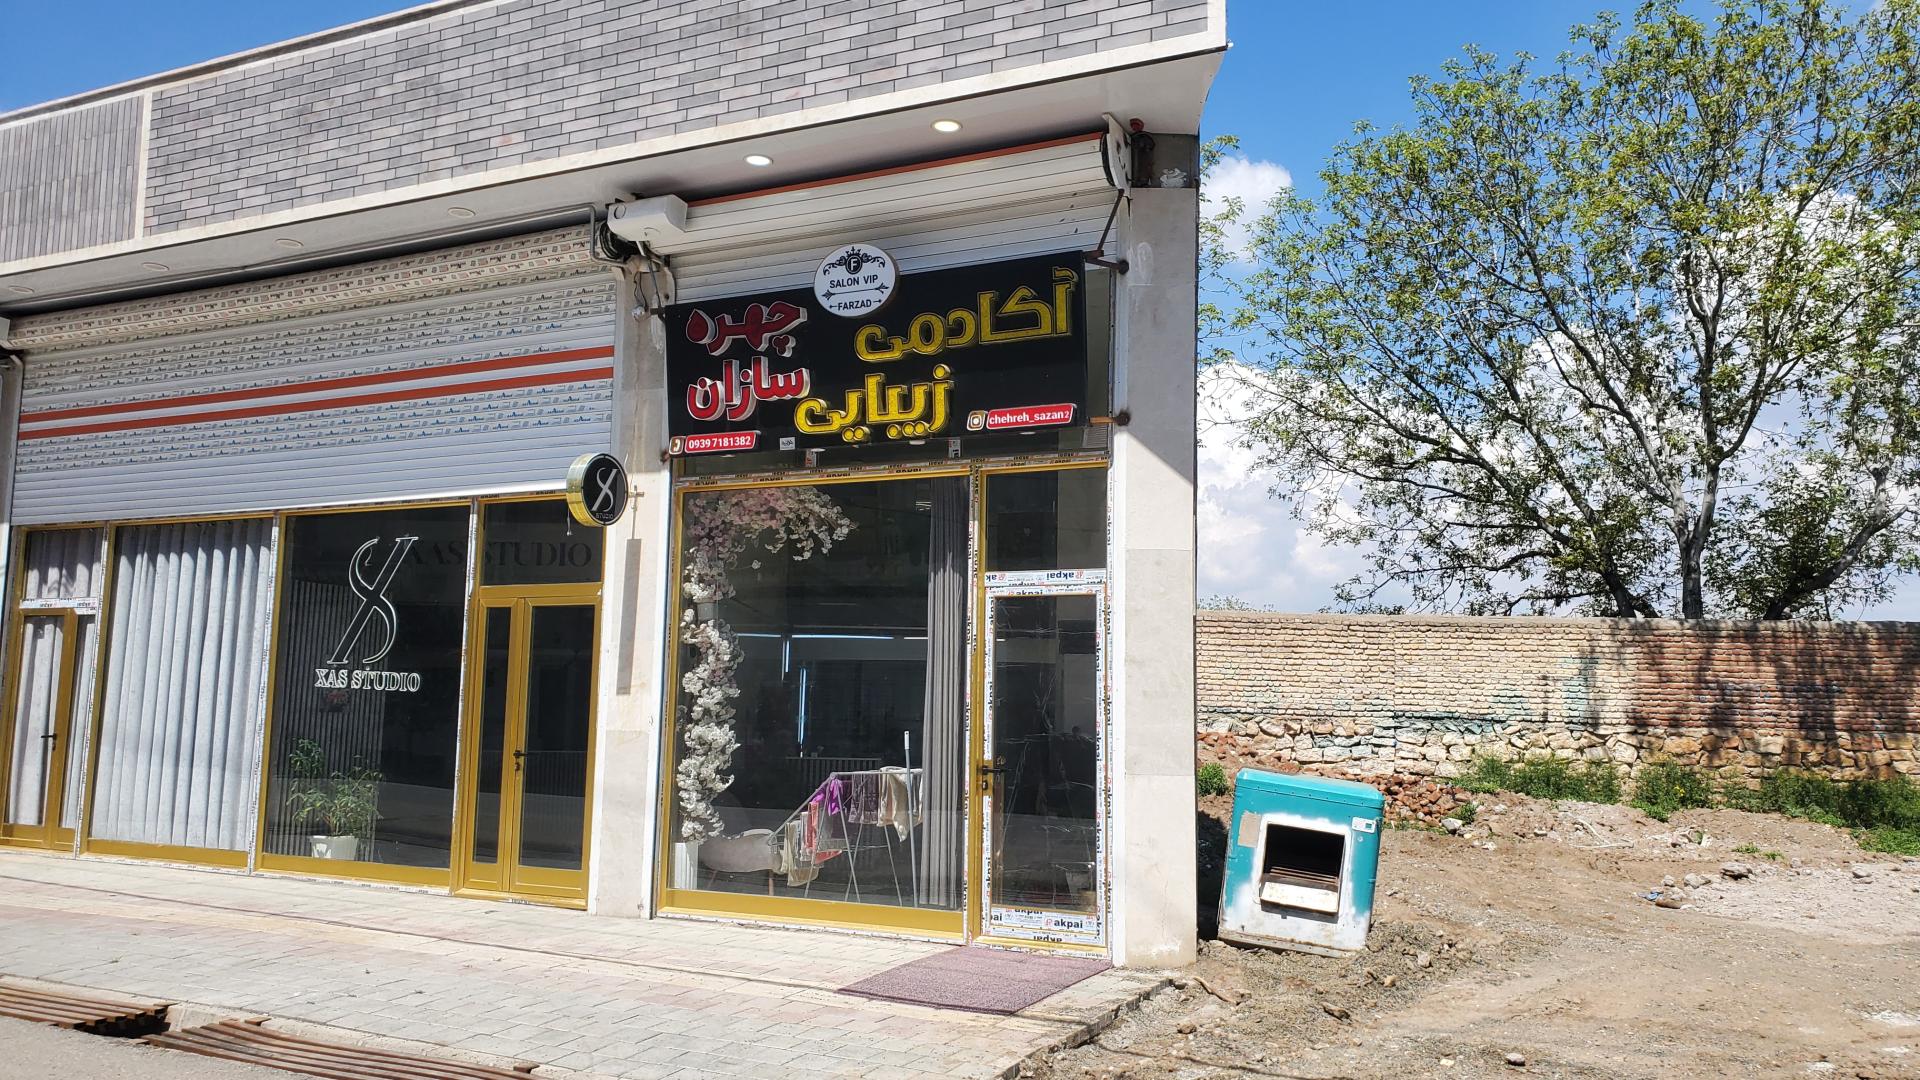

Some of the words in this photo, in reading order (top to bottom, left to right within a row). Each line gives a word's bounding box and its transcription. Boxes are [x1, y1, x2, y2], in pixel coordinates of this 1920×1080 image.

[829, 276, 860, 289] SALON
[863, 274, 879, 285] VIP
[837, 299, 872, 311] FARZAD
[686, 301, 807, 356] چهره
[687, 356, 810, 421] سازان
[794, 364, 954, 443] زیبایی
[989, 411, 1070, 425] chehreh_sazan2
[314, 668, 349, 689] XAS
[350, 669, 421, 692] STUDIO
[1053, 918, 1083, 930] akpai
